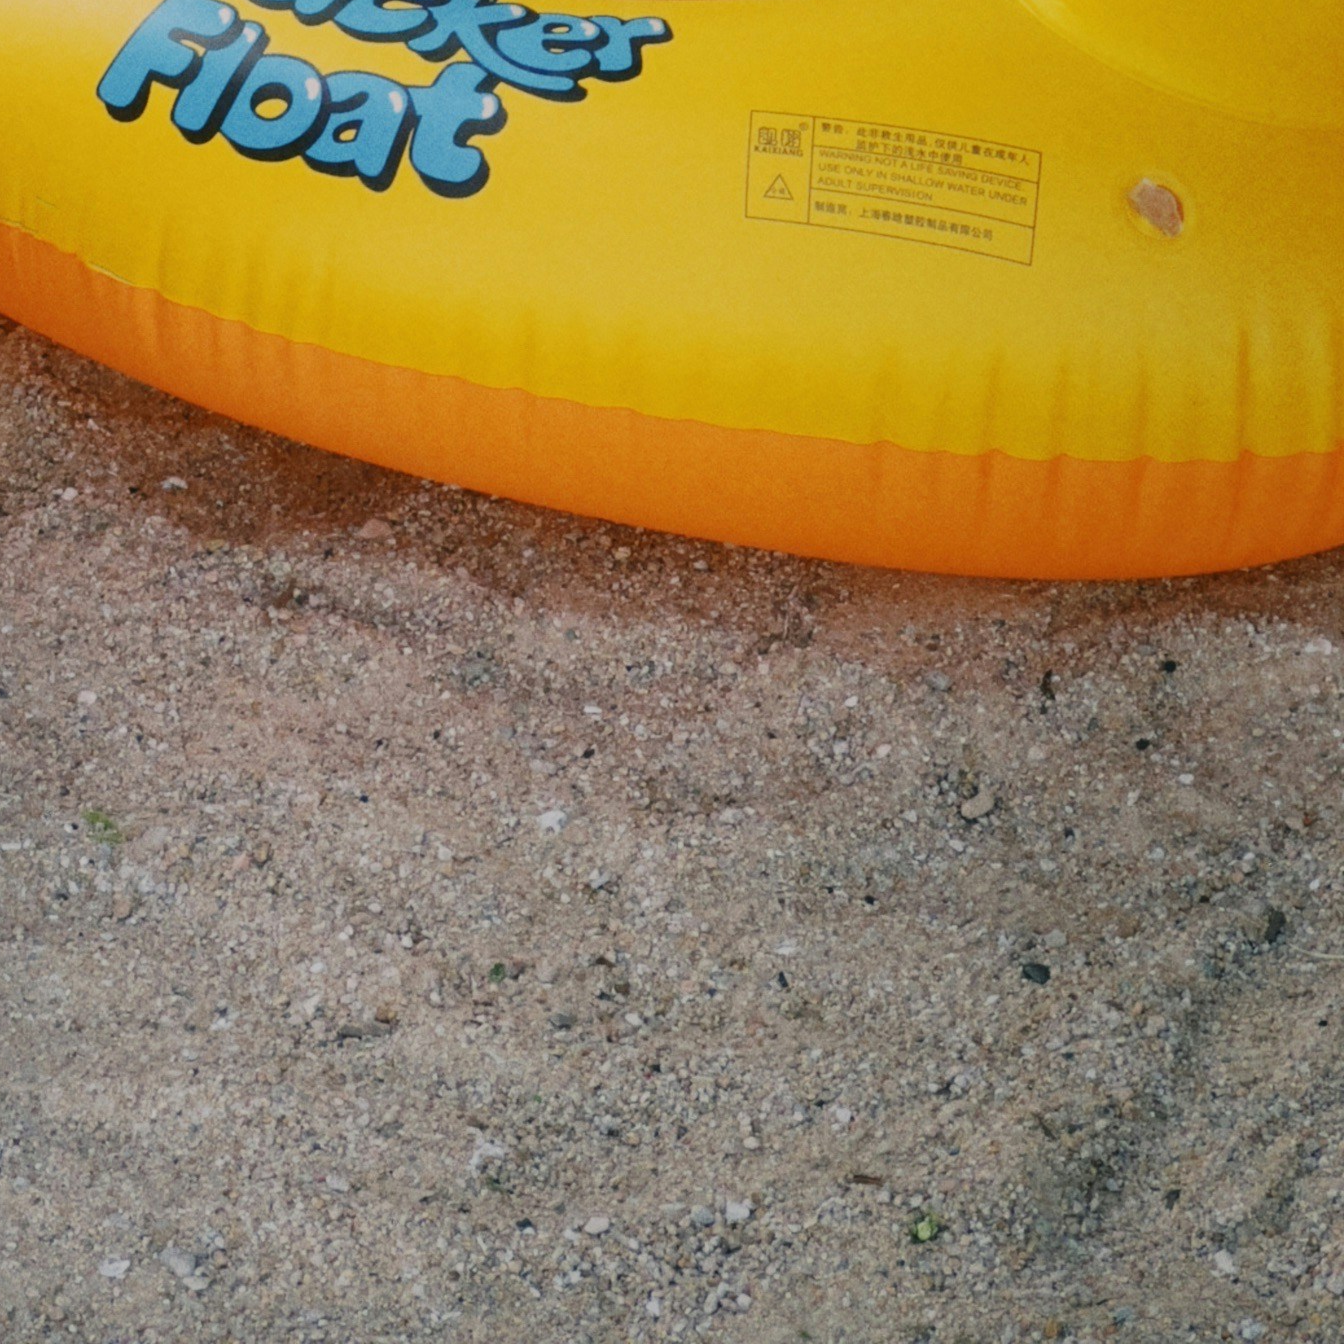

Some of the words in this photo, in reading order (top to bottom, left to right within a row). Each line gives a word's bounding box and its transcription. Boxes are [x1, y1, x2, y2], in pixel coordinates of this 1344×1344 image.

[753, 145, 804, 157] KAIXIANG
[874, 155, 897, 167] NOT
[899, 159, 910, 170] A
[910, 161, 935, 174] LIFE
[937, 166, 978, 182] SAVING
[816, 176, 852, 189] ADULT
[855, 182, 934, 201] SUPERVISION
[818, 163, 840, 173] USE
[844, 165, 875, 178] ONLY
[876, 170, 888, 180] IN
[889, 172, 945, 189] SHALLOW
[947, 181, 987, 197] WATER
[988, 190, 1028, 206] UNDER
